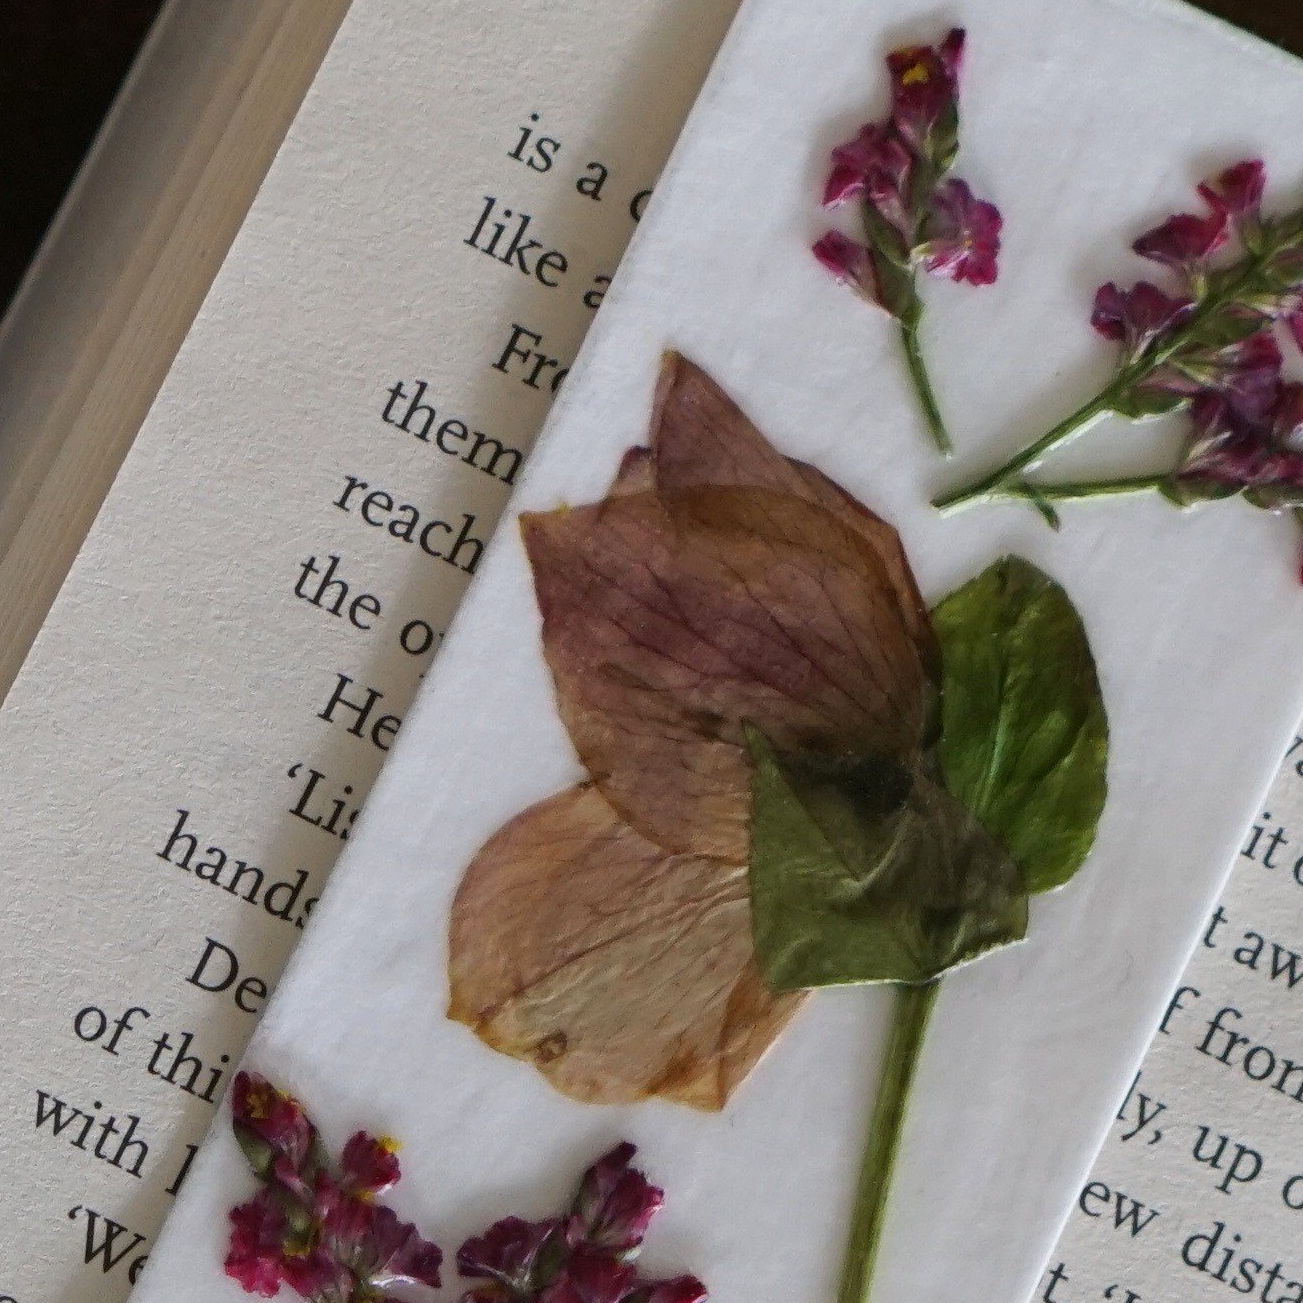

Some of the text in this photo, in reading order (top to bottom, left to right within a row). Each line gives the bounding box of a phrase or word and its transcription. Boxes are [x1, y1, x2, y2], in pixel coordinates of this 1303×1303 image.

[506, 112, 609, 202] is a
[464, 196, 569, 288] like
[294, 555, 381, 630] the
[73, 1006, 150, 1056] of
[35, 1090, 148, 1178] with
